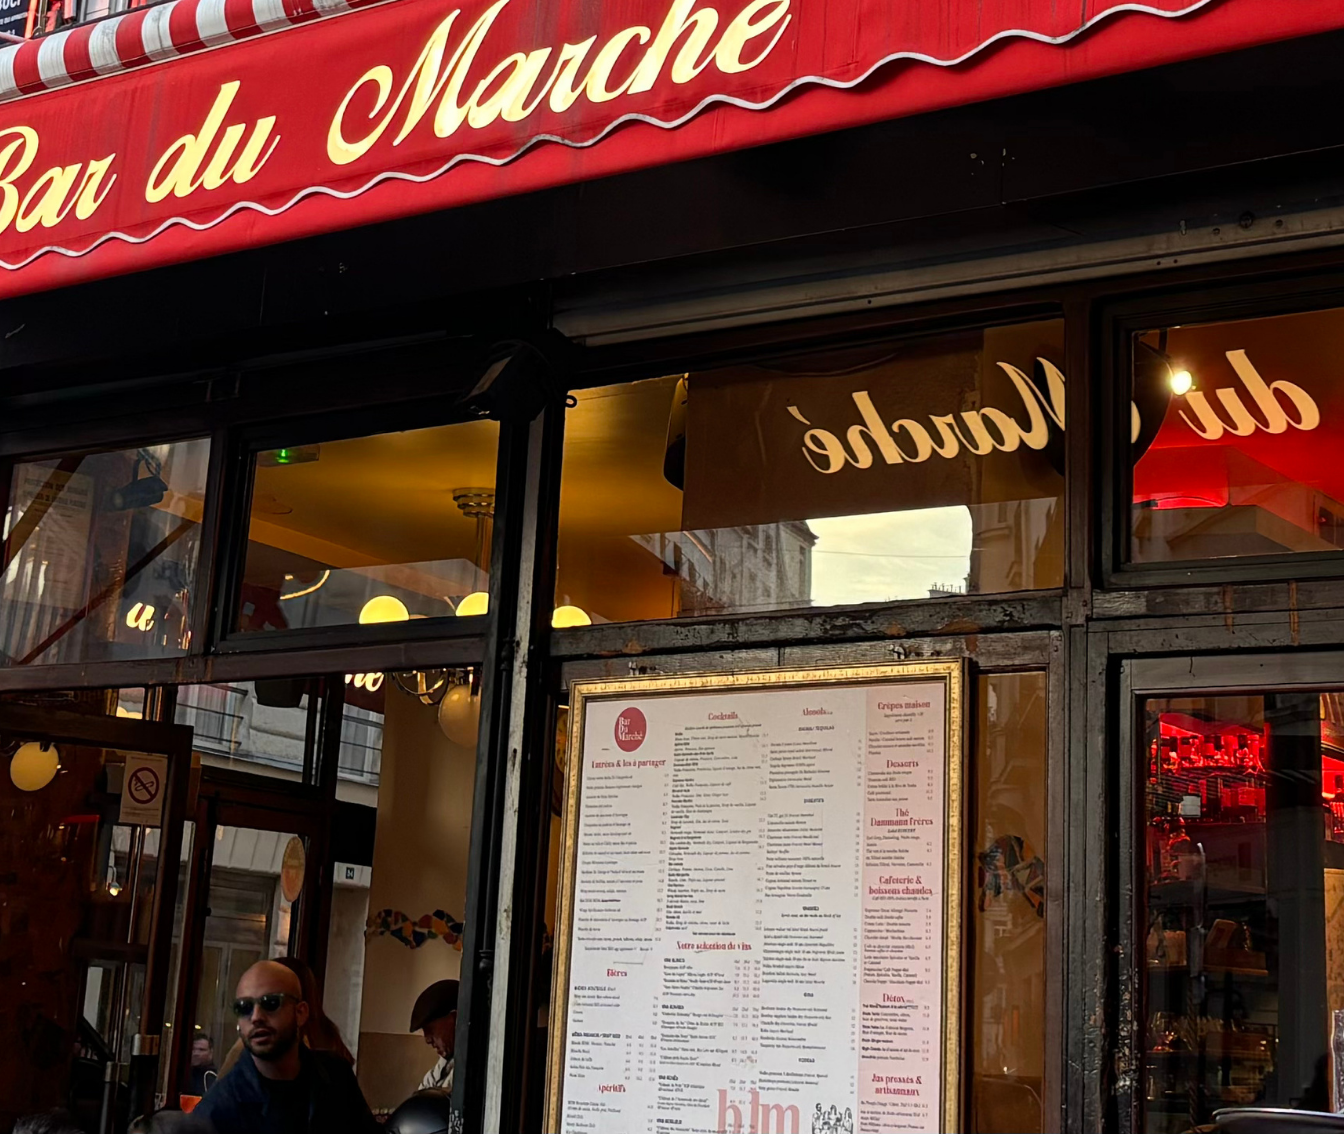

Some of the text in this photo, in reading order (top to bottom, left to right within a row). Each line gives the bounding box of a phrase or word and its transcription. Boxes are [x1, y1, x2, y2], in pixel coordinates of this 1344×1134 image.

[144, 81, 281, 205] du
[708, 711, 738, 721] Cocktails
[637, 759, 666, 769] partager
